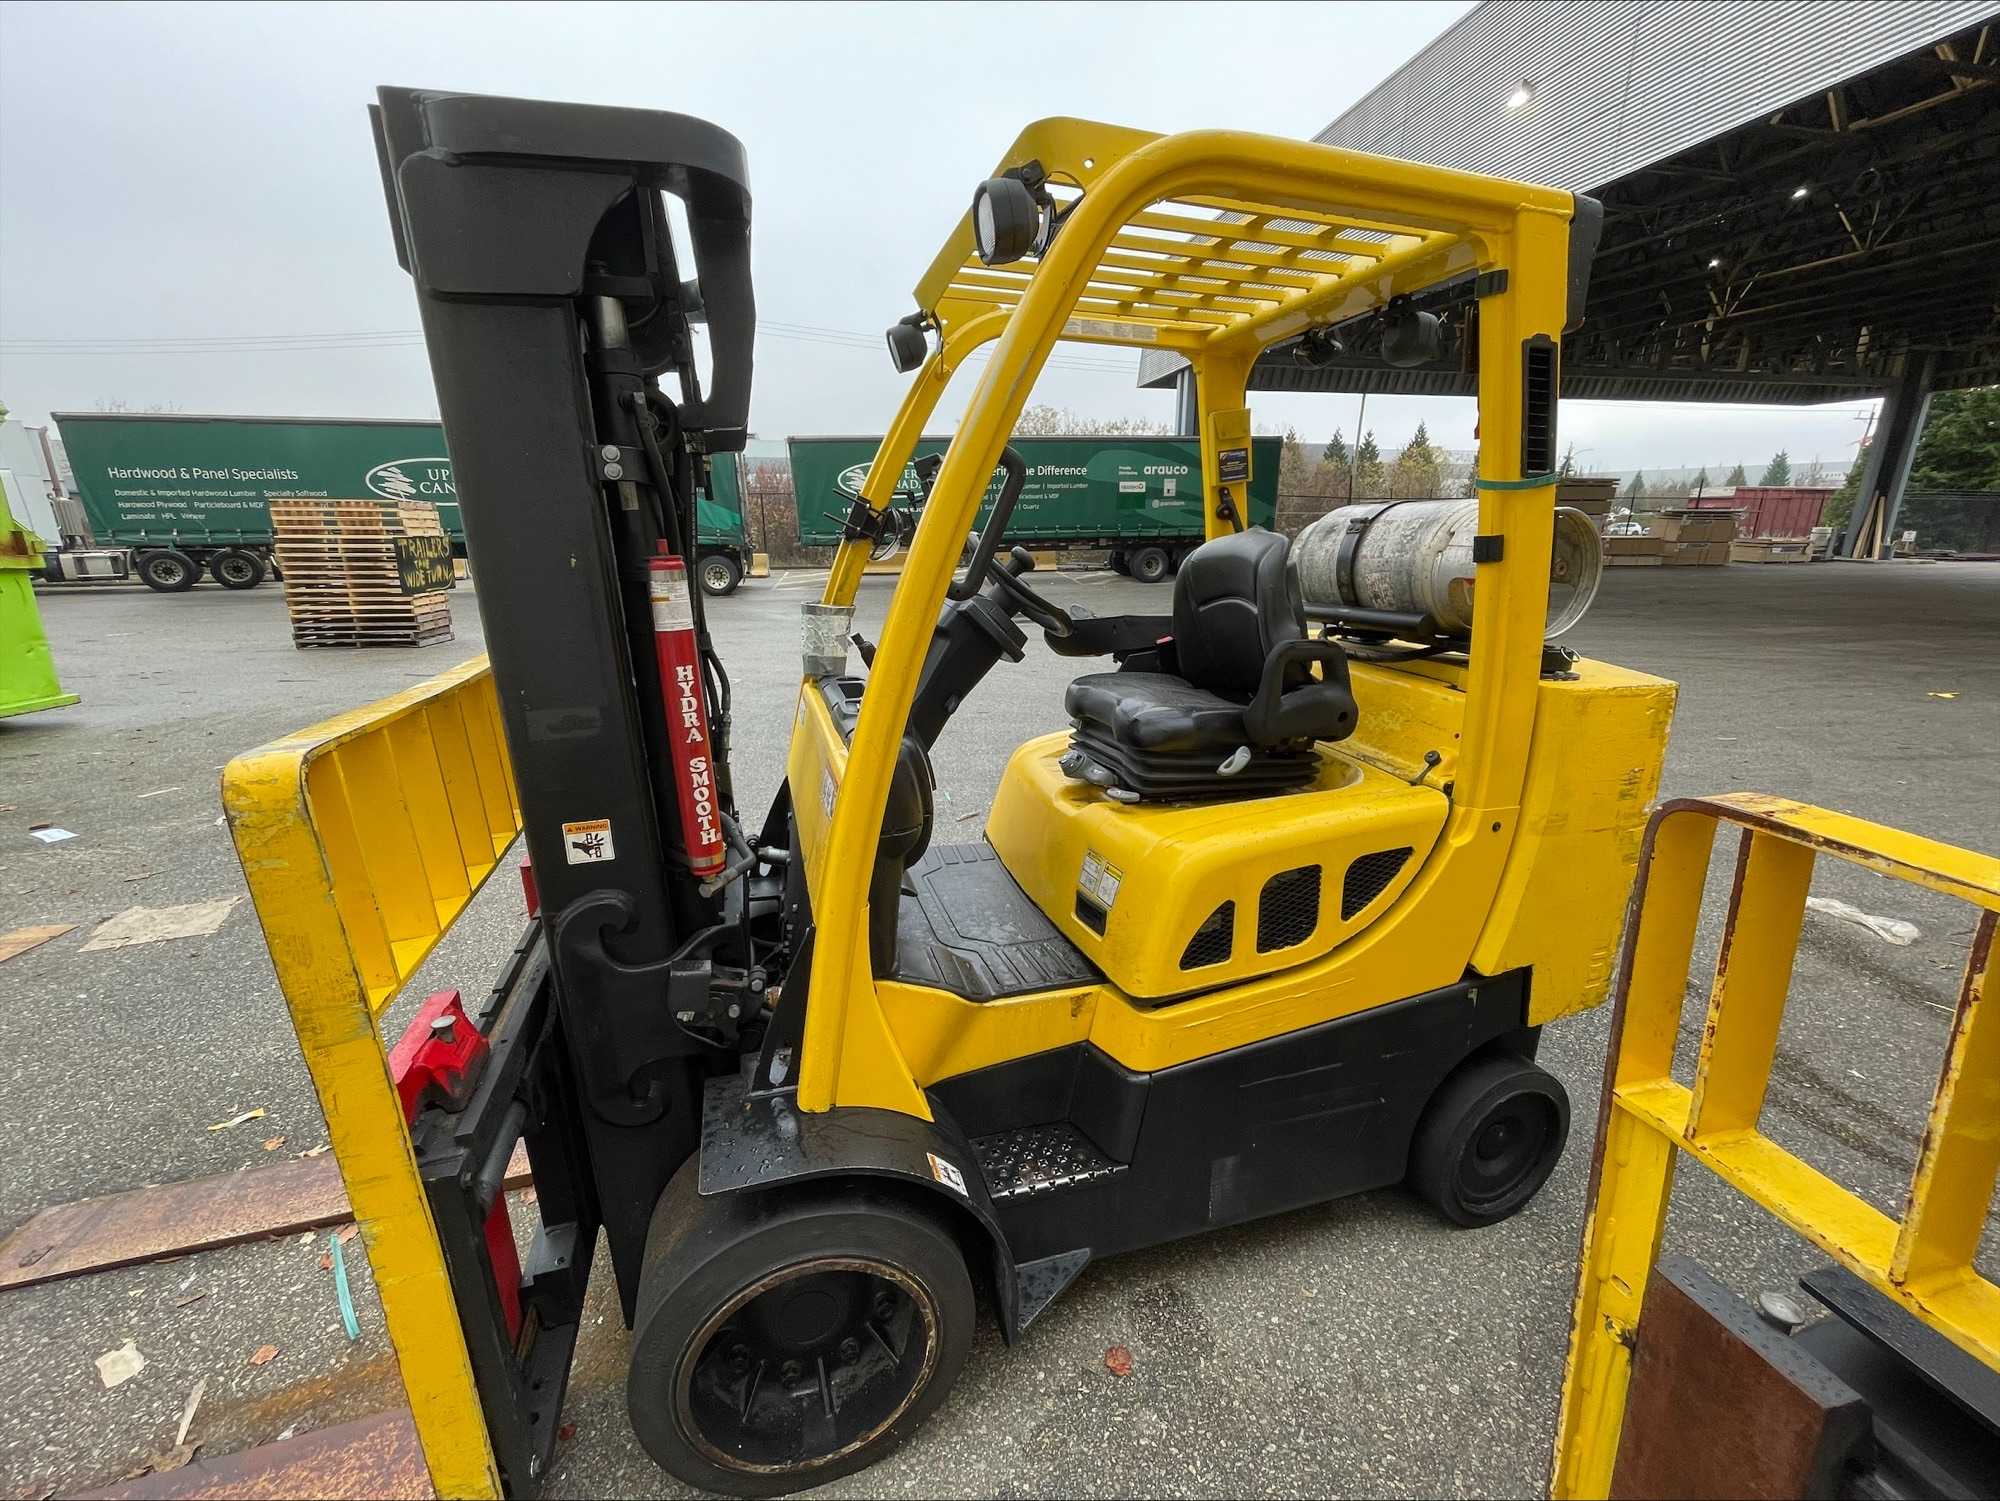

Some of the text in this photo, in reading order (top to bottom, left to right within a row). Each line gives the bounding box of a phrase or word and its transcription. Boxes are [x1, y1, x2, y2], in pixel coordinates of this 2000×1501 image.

[107, 466, 299, 482] Hardwood & Panel Specialists
[426, 469, 449, 480] UP
[1037, 465, 1088, 476] Difference
[1143, 465, 1189, 475] arauco
[419, 481, 456, 494] CAN
[398, 537, 450, 559] TRAILERS
[675, 665, 716, 845] HYDRA SMOOTH
